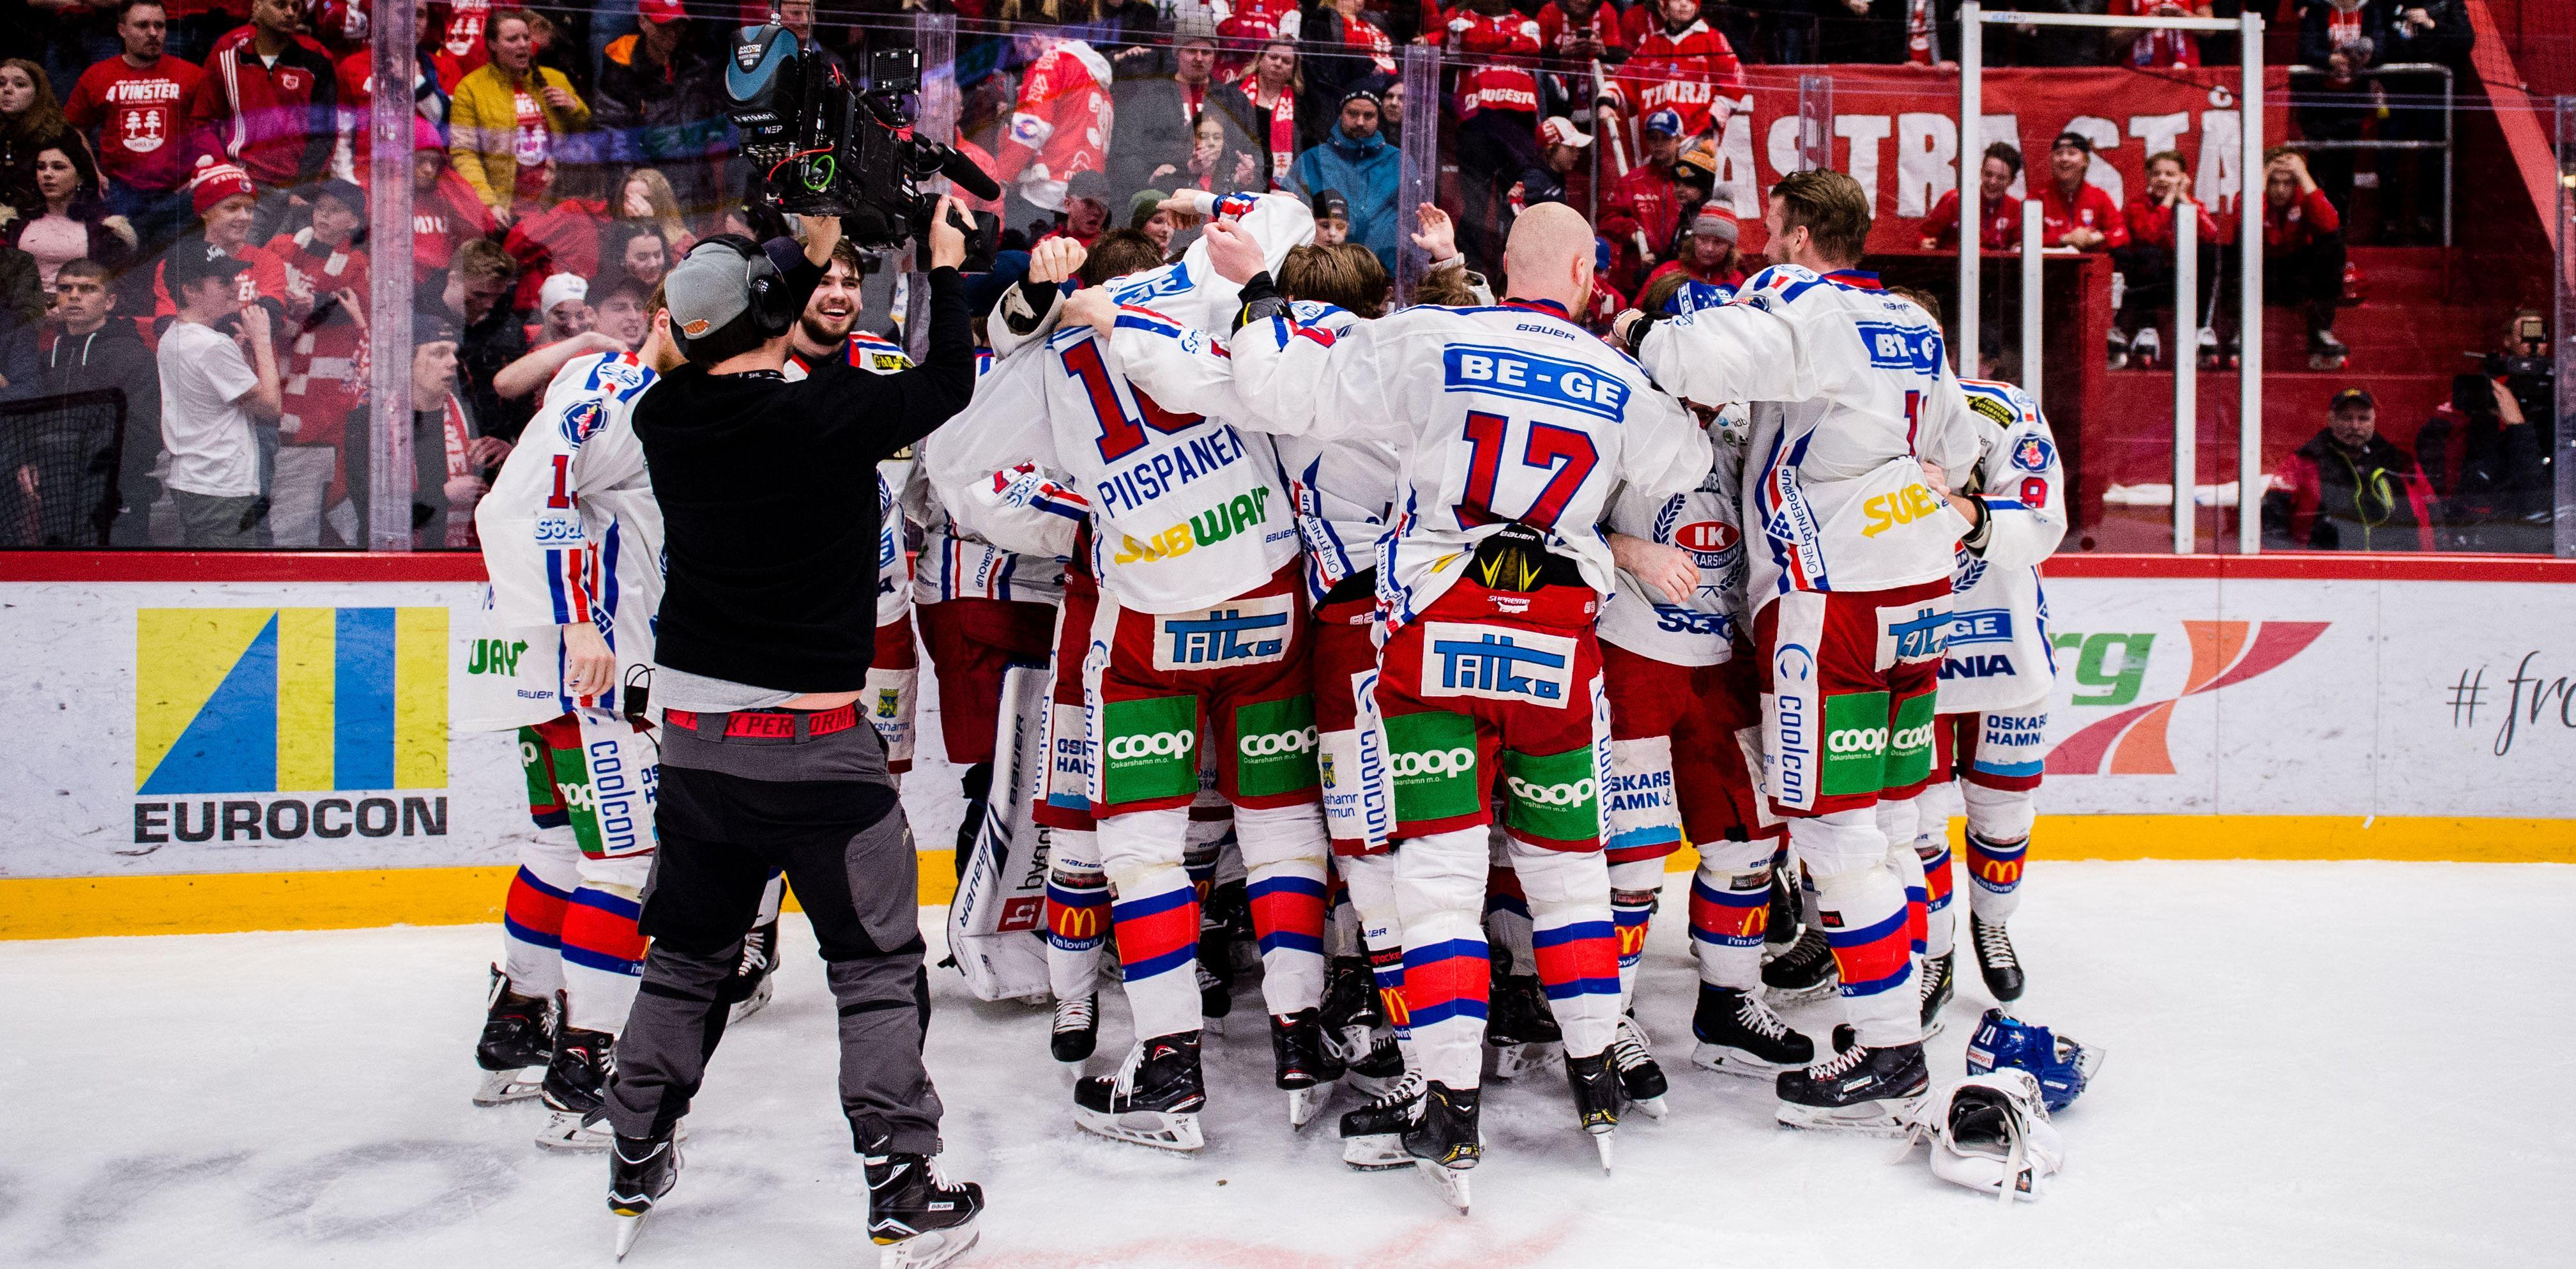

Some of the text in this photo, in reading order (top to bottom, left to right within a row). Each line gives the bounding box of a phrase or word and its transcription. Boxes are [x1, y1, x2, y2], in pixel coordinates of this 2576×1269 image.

[105, 82, 180, 102] 4 VINSTER
[765, 125, 783, 134] NEP
[1097, 424, 1248, 519] PIISPANEN
[1452, 410, 1599, 535] 17
[2020, 477, 2048, 509] 9
[1499, 530, 1536, 541] BAUER
[1695, 526, 1725, 547] IK
[1106, 729, 1194, 760] coop
[1240, 725, 1319, 757] coop
[1779, 695, 1810, 804] coolcon
[1827, 727, 1889, 755] coop
[1985, 730, 2041, 747] HAMN
[1110, 758, 1156, 769] Oskarshamn
[1389, 746, 1475, 779] coop
[590, 739, 636, 850] coolcon
[1394, 778, 1425, 786] skarshamn
[1507, 776, 1596, 808] coop
[1612, 792, 1660, 811] AMN
[134, 796, 448, 844] EUROCON
